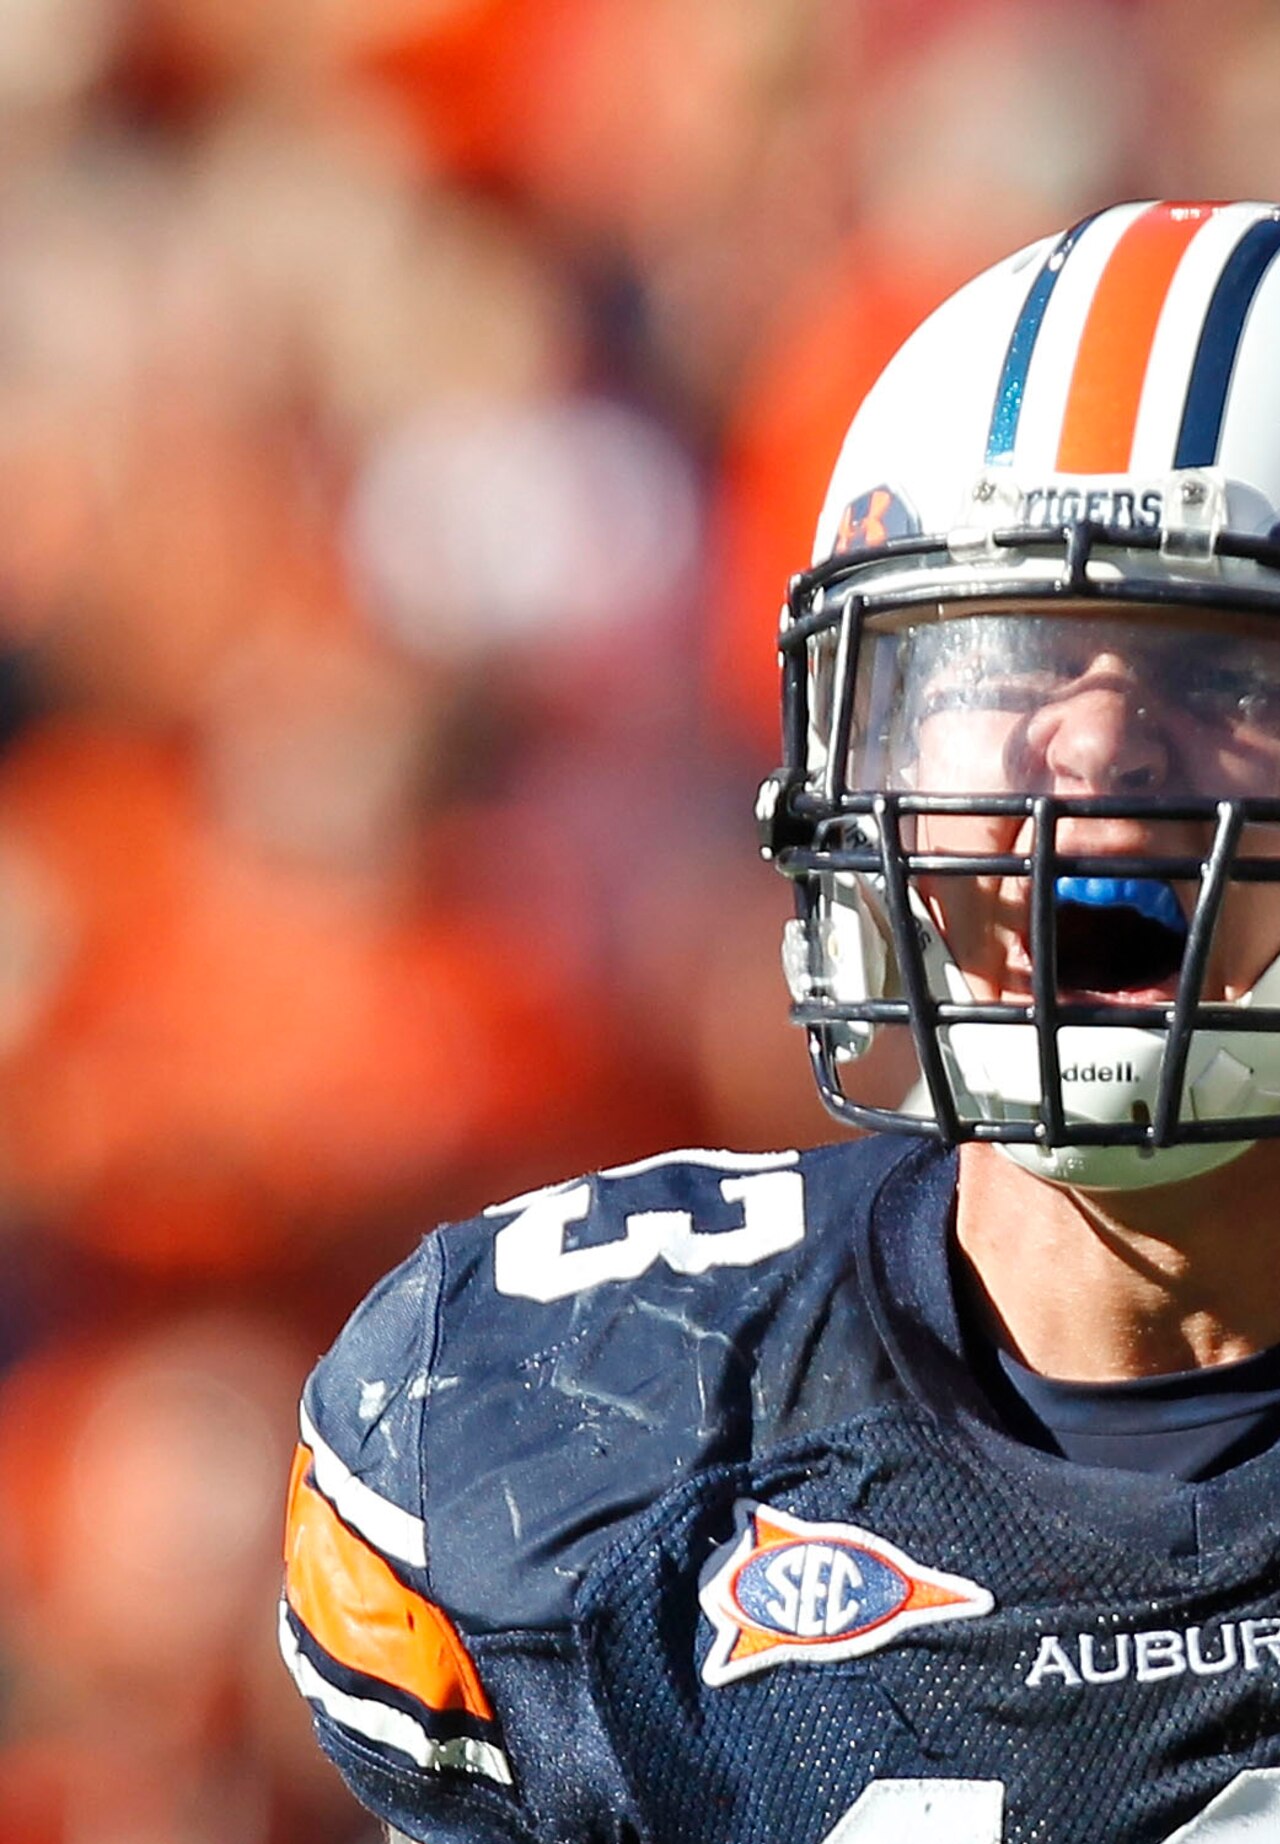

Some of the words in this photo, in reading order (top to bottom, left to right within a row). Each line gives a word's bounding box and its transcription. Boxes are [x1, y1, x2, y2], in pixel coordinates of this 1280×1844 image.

[1023, 488, 1163, 532] TIGERS
[1060, 1062, 1140, 1082] ddell.
[765, 1544, 864, 1636] SEC
